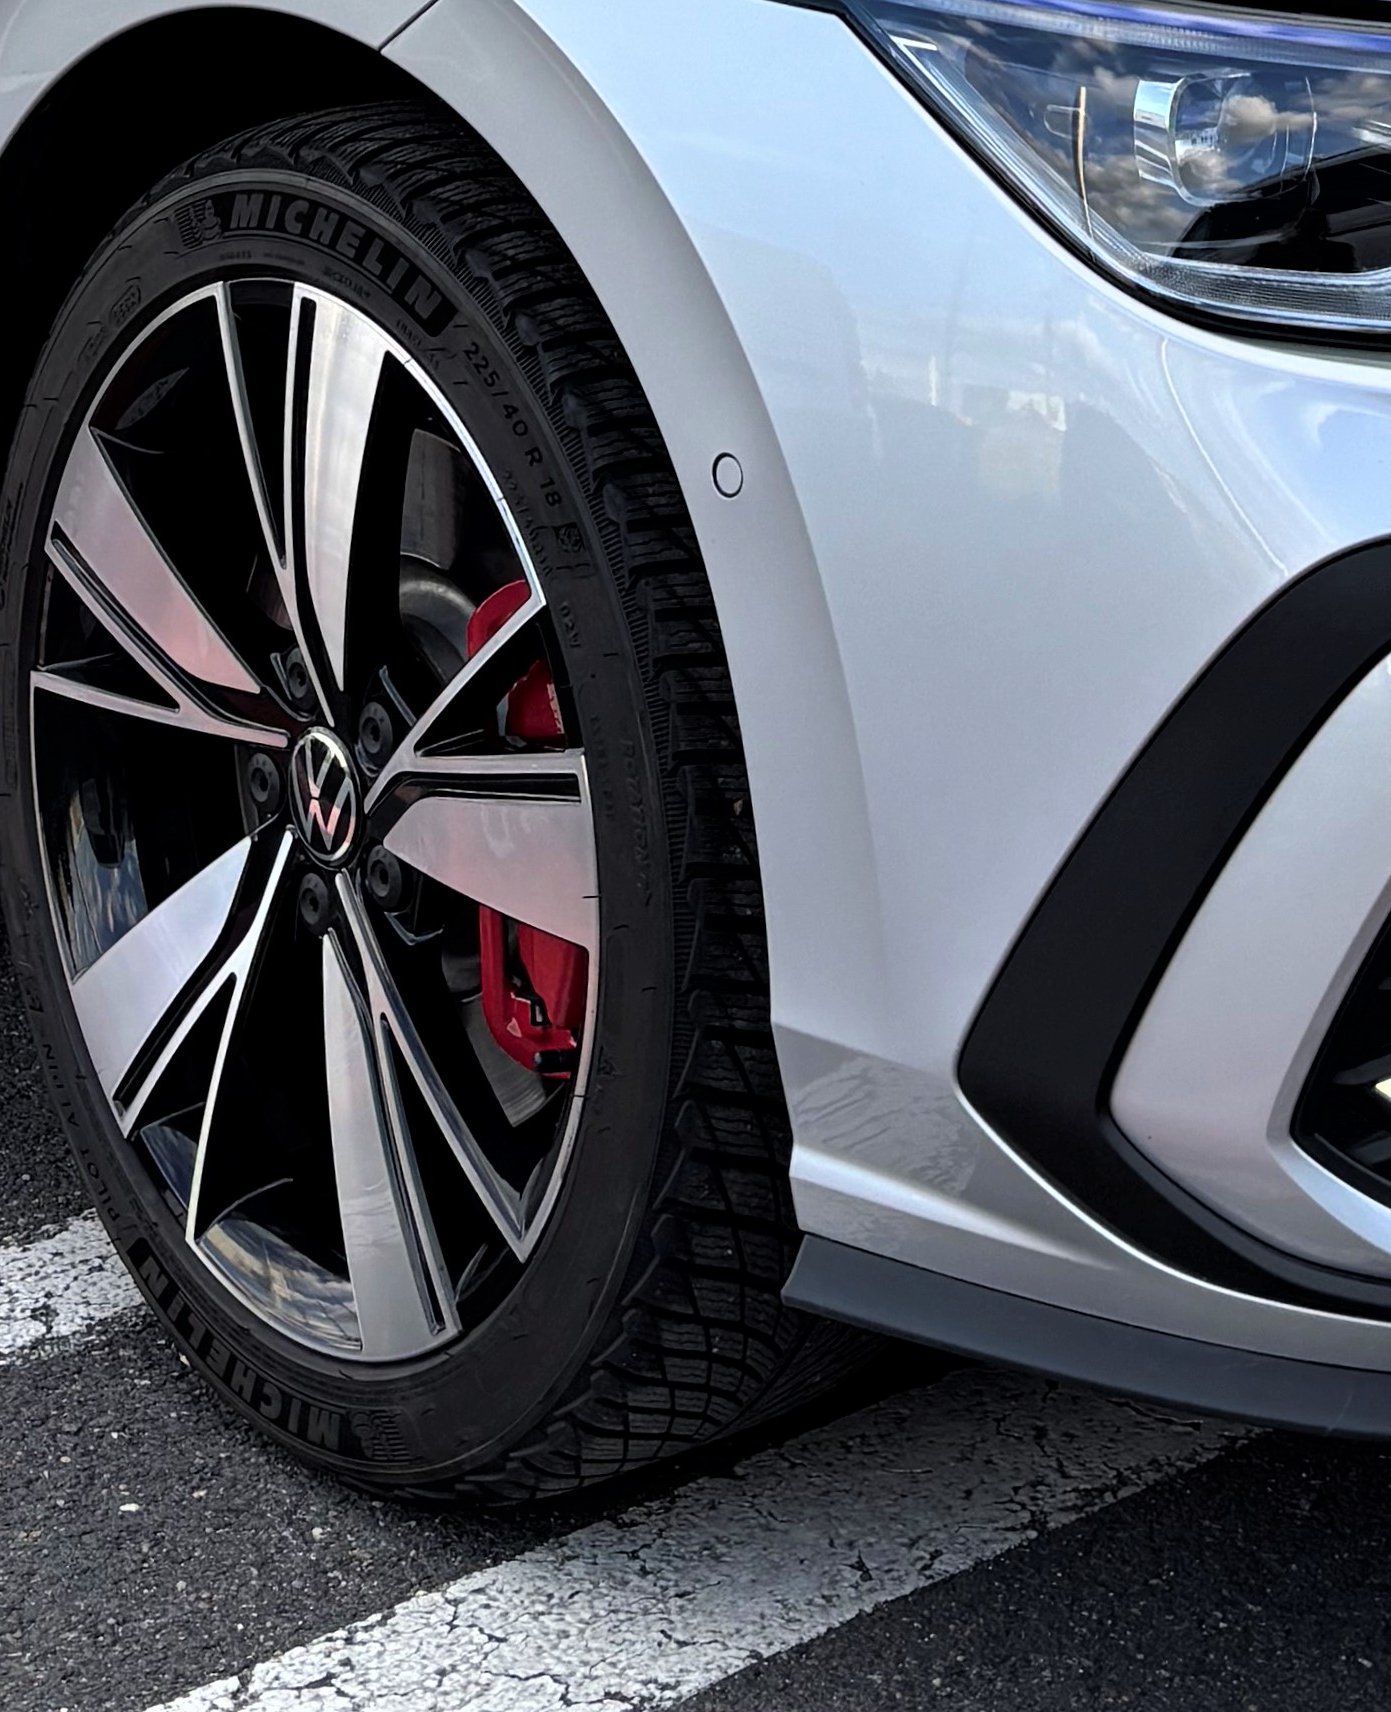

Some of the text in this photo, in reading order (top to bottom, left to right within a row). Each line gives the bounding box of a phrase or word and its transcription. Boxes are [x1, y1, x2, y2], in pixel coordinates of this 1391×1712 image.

[229, 192, 444, 320] MICHELIN
[461, 341, 531, 439] 225/40
[524, 444, 546, 469] R
[539, 477, 564, 509] 18
[137, 1249, 343, 1454] MICHELIN
